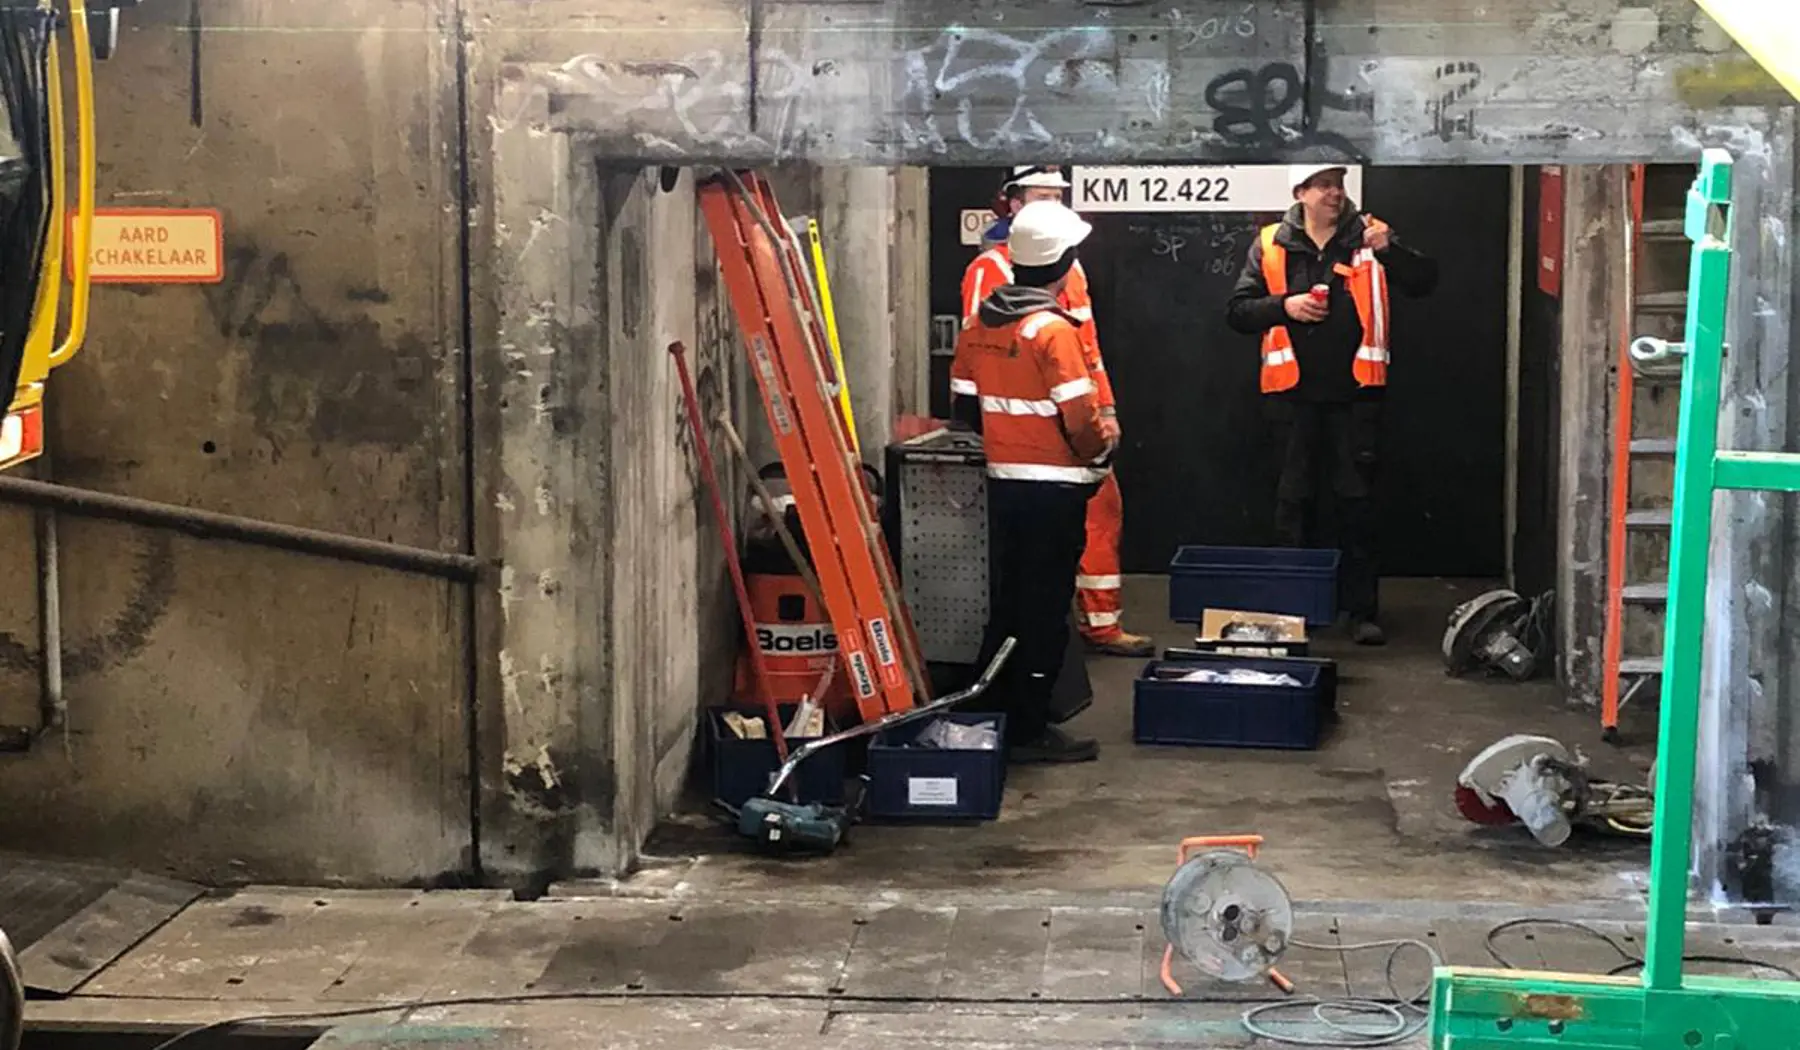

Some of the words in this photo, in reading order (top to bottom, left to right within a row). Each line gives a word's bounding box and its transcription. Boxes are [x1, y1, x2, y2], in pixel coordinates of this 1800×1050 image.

[1083, 178, 1128, 201] KM
[1140, 177, 1230, 202] 12.422
[119, 226, 169, 243] AARD
[755, 629, 839, 651] Boels
